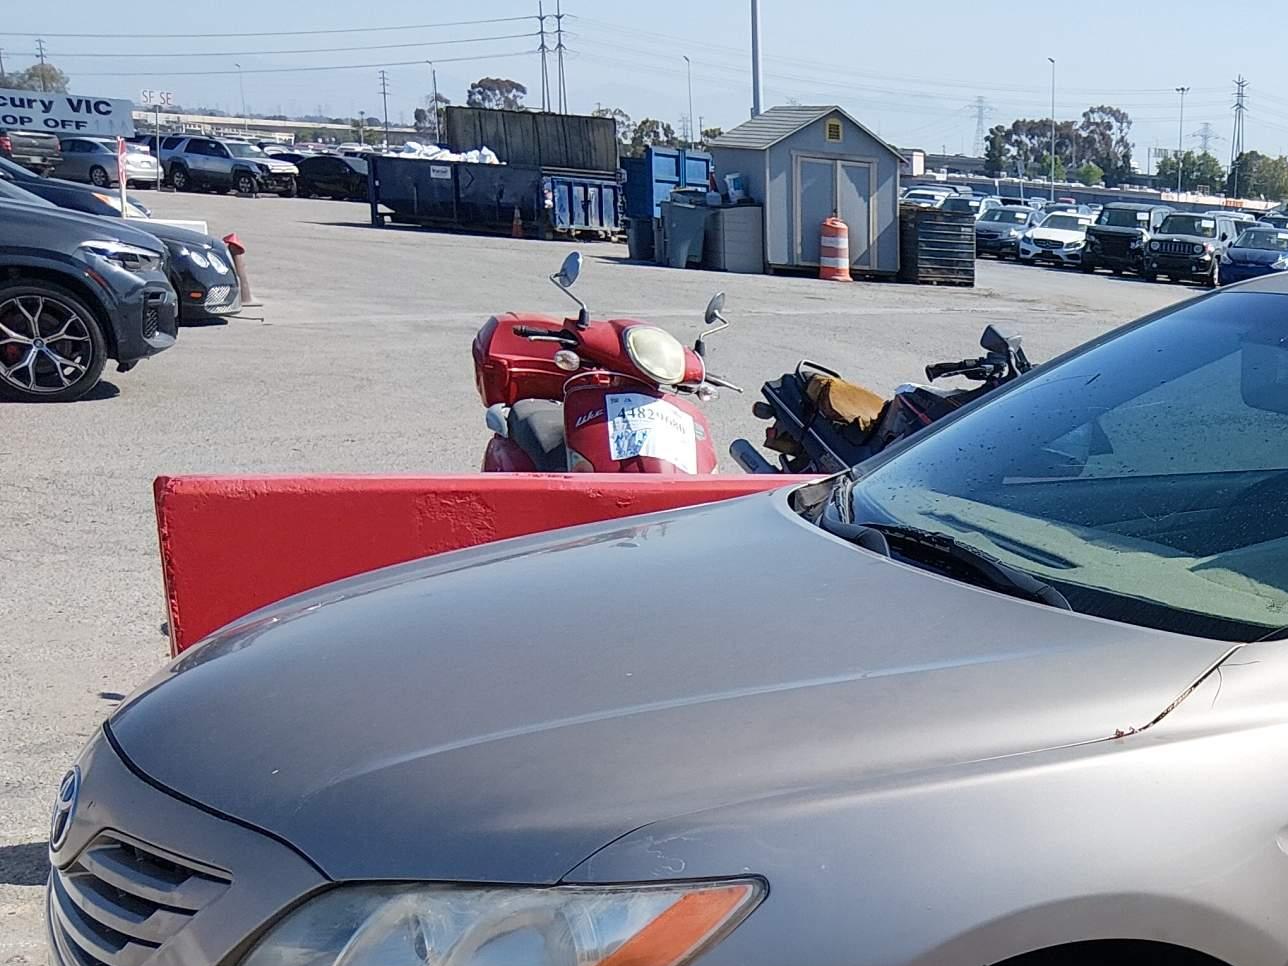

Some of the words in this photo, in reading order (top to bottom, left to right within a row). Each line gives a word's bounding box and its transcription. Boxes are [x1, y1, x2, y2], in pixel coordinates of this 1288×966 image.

[142, 89, 155, 104] SF
[159, 91, 172, 105] SE
[66, 98, 113, 116] VIC
[0, 114, 33, 126] OP
[43, 118, 88, 130] OFF
